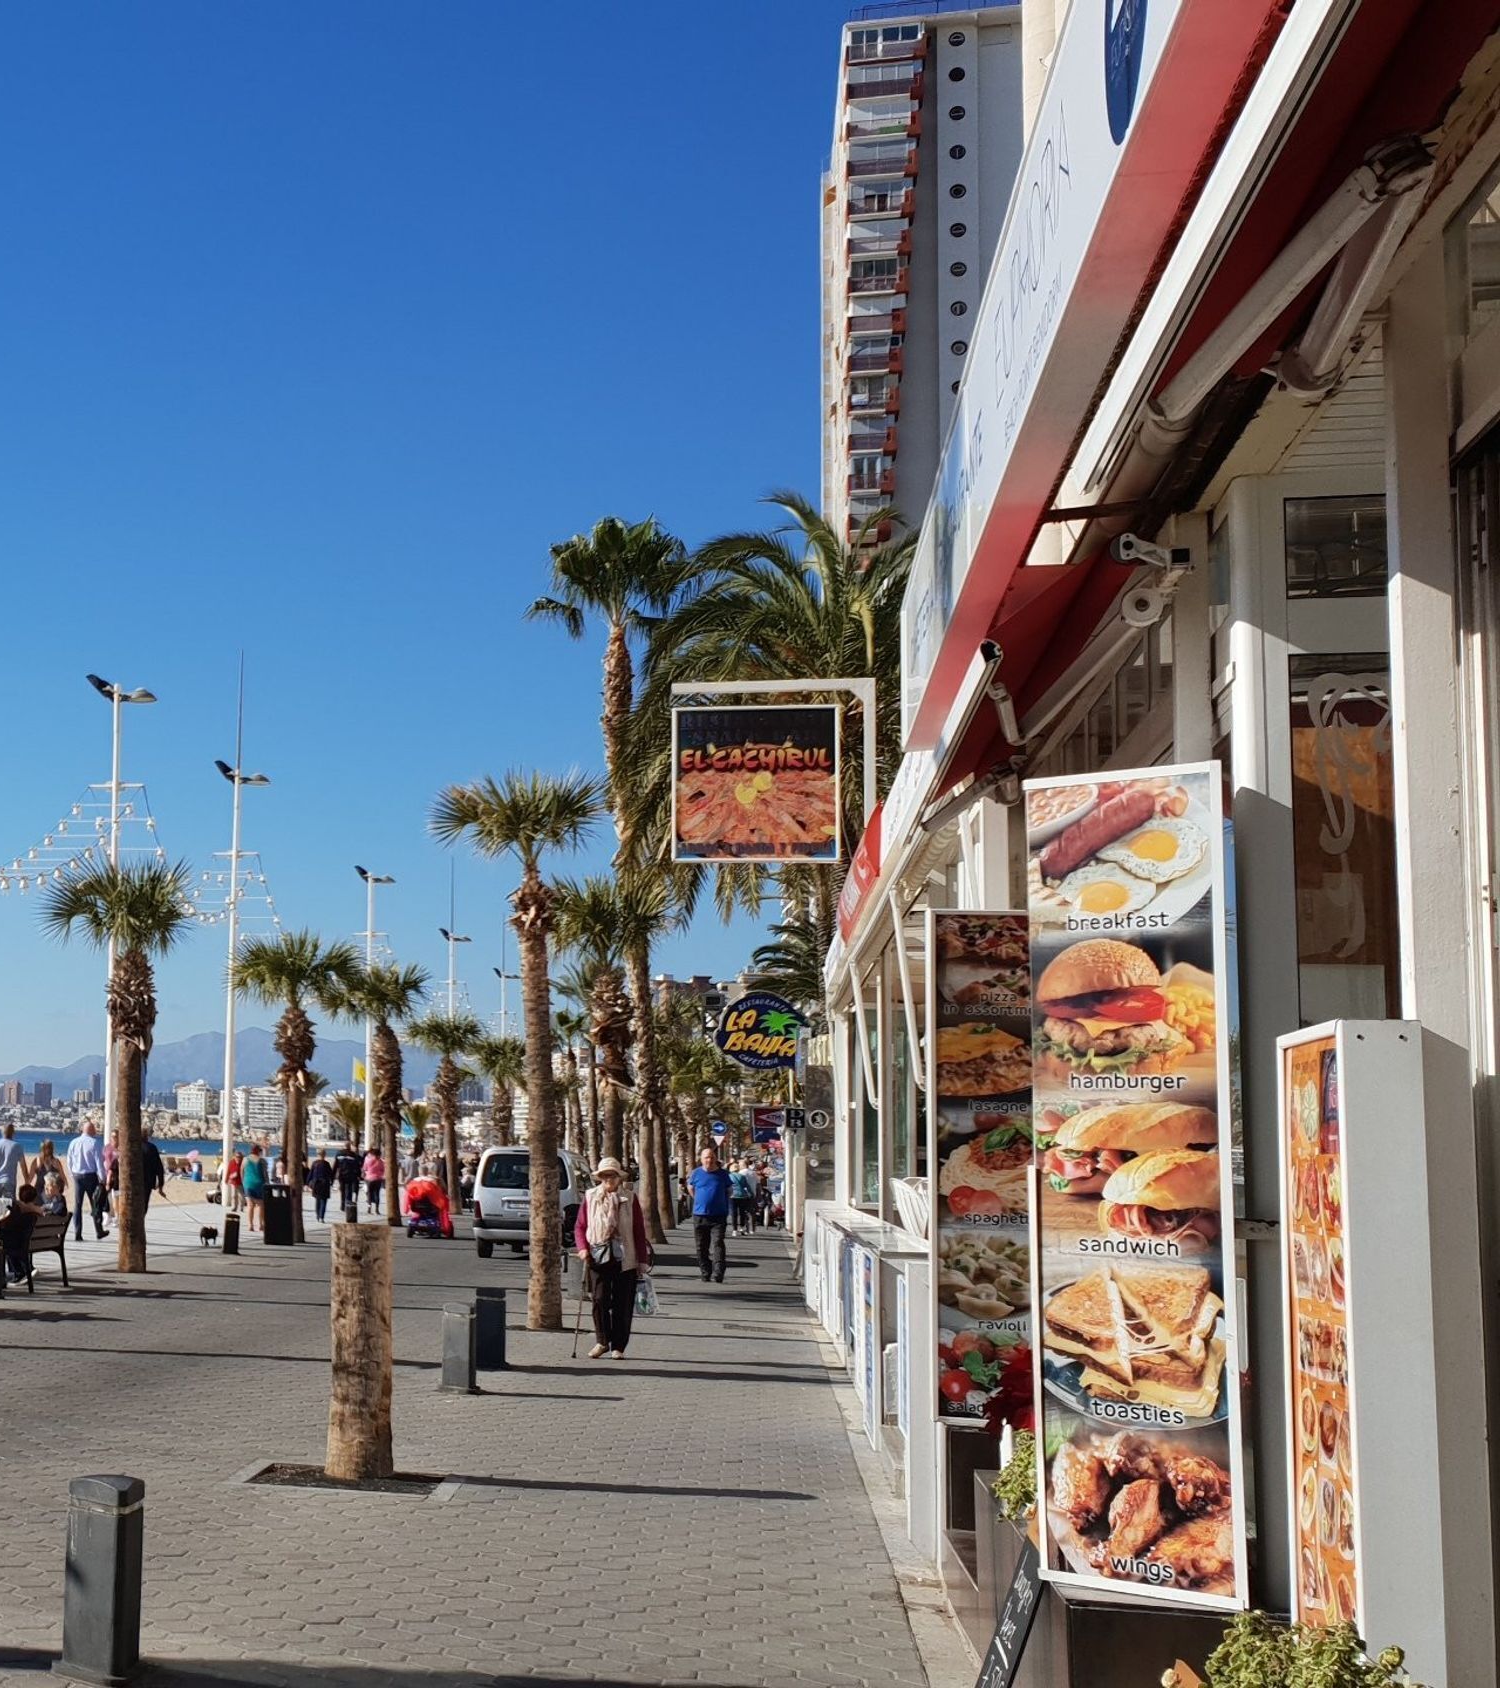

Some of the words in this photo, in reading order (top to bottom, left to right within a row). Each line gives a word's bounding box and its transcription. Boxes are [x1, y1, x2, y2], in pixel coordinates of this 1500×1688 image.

[680, 749, 707, 770] EL
[1067, 911, 1170, 931] breakfast
[980, 992, 1018, 1004] pizza
[944, 1004, 959, 1015] in
[725, 1009, 757, 1032] LA
[1070, 1072, 1187, 1093] hamburger
[968, 1099, 1028, 1114] lasagne
[965, 1213, 1029, 1226] spaghett
[1079, 1236, 1180, 1257] sandwich
[978, 1320, 1027, 1332] ravioli
[1092, 1398, 1185, 1426] toasties
[1111, 1555, 1174, 1582] wings
